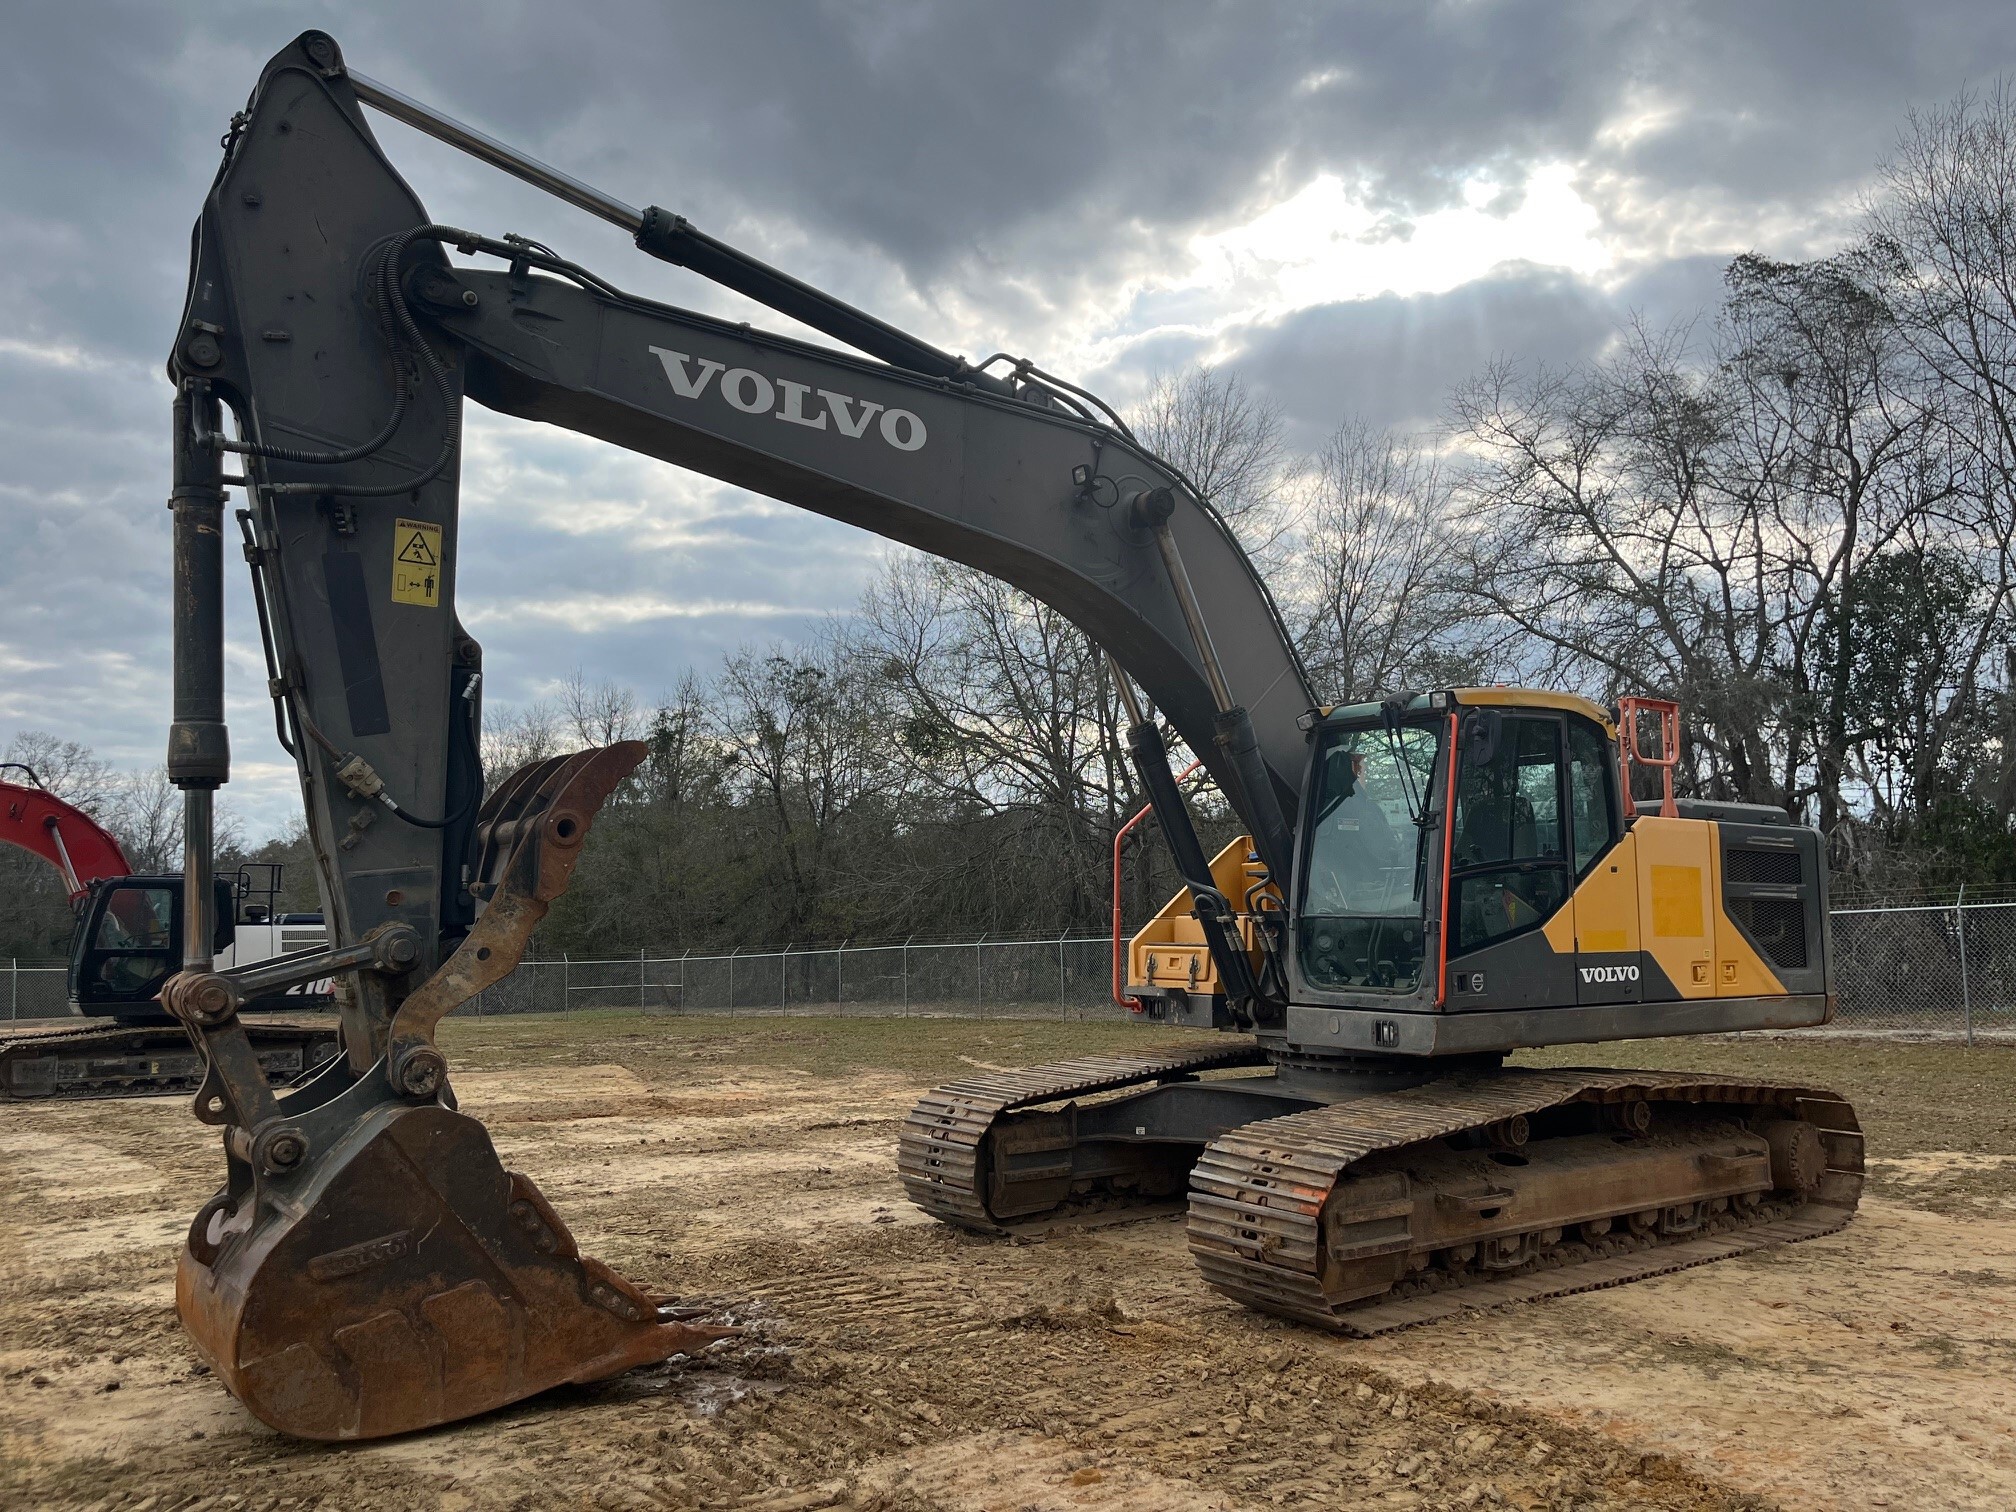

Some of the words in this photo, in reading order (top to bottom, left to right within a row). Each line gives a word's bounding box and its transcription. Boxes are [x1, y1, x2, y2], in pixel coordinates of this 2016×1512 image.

[649, 345, 927, 451] VOLVO
[406, 522, 438, 532] WARNING
[1580, 965, 1639, 983] VOLVO
[322, 1238, 407, 1276] OLVO
